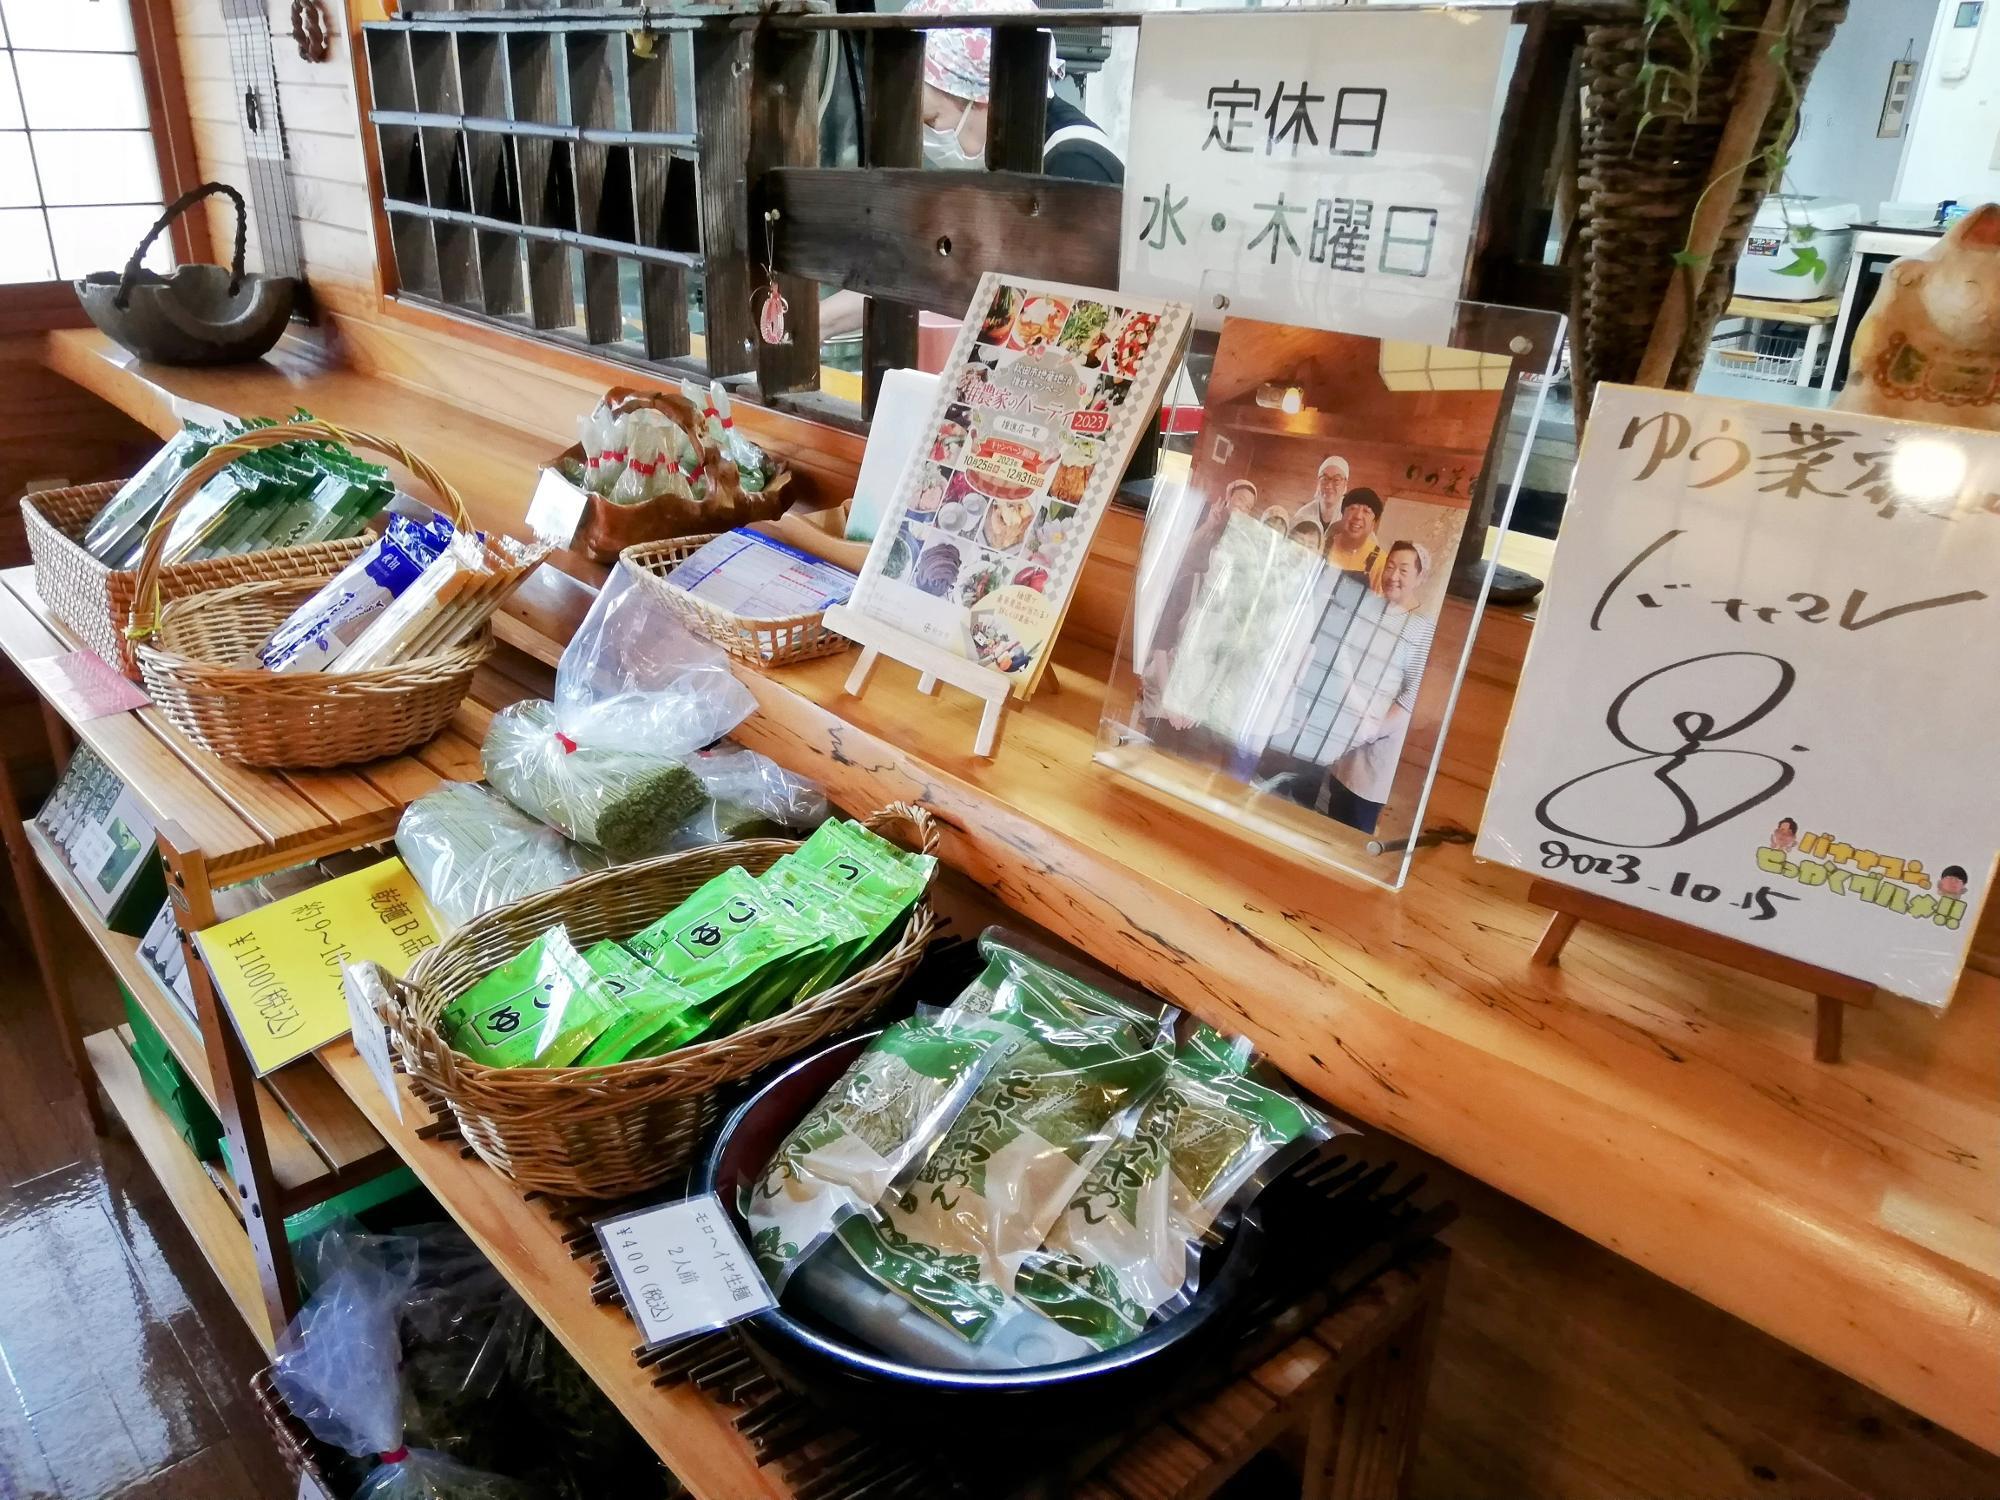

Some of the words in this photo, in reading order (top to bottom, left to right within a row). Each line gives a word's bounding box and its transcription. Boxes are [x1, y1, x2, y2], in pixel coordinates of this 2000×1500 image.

[1202, 79, 1388, 158] 定休日
[1138, 183, 1439, 278] 水・木曜日
[1075, 415, 1104, 429] 2023
[667, 1246, 700, 1286] 2人前
[695, 1212, 754, 1302] モロヘイヤ生麺
